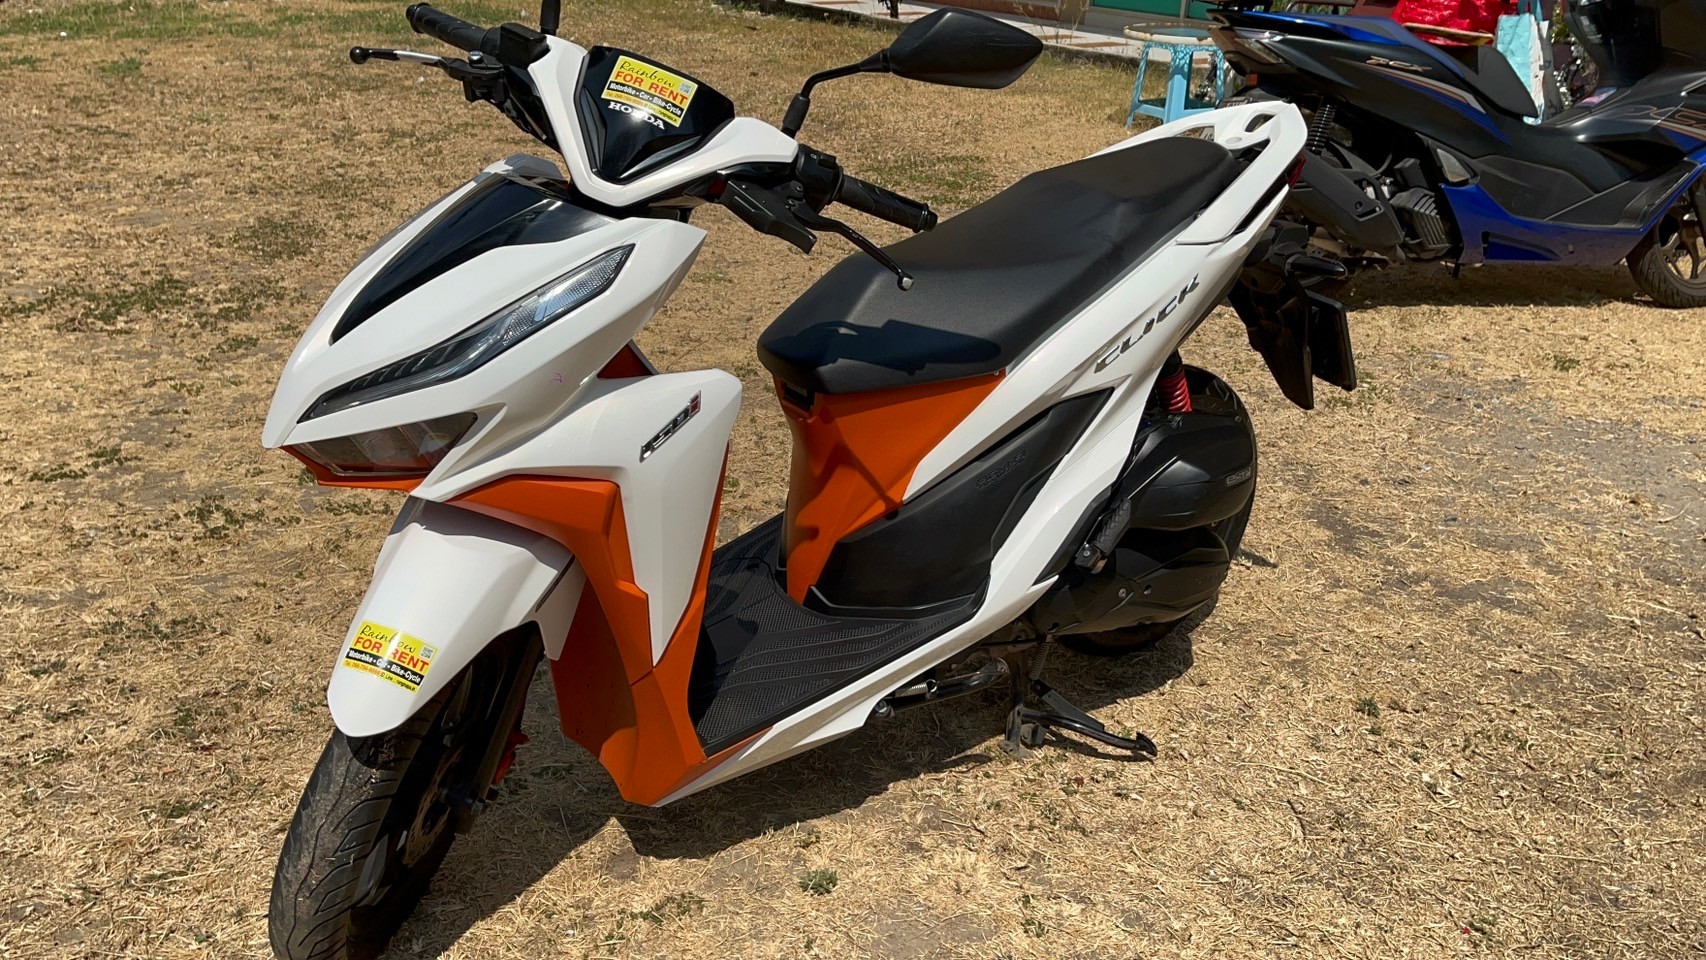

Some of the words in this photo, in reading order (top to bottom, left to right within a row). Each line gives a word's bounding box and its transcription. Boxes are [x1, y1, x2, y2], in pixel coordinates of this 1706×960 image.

[614, 71, 644, 87] FOR
[648, 82, 688, 105] RENT
[619, 61, 674, 88] Rainbow
[609, 83, 636, 95] Motorbike
[639, 91, 650, 100] Car
[652, 97, 682, 115] Bike-Cycle
[1094, 273, 1200, 374] CLICK
[348, 650, 373, 663] Motorbike
[390, 664, 421, 683] Bike-Cycle
[353, 636, 383, 654] FOR
[391, 647, 429, 672] RENT
